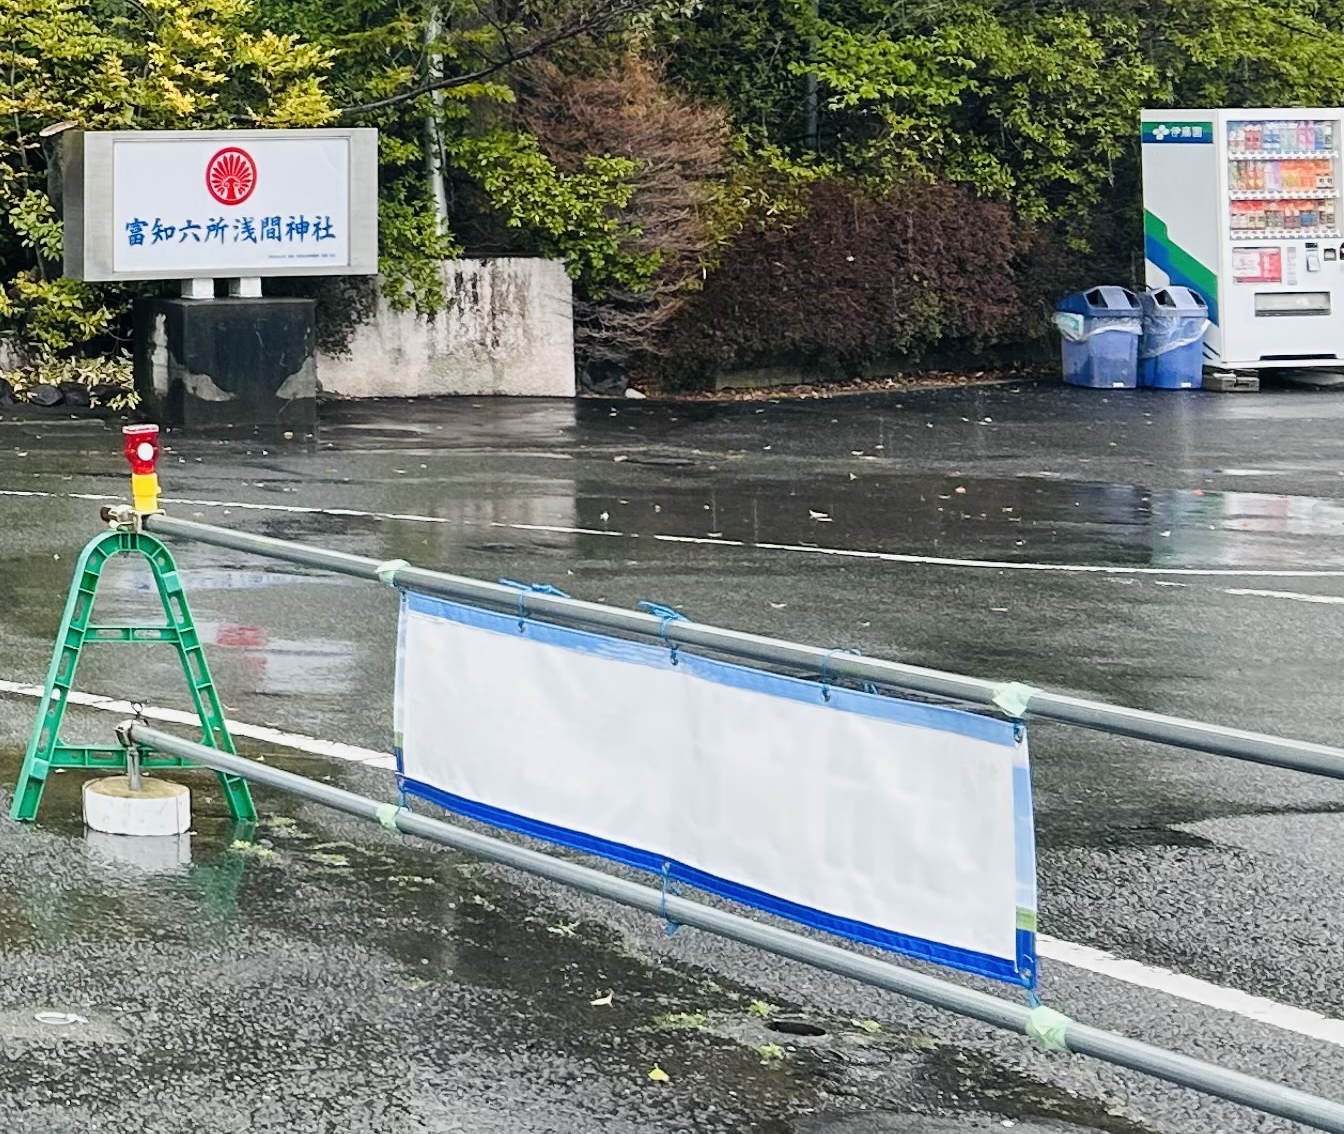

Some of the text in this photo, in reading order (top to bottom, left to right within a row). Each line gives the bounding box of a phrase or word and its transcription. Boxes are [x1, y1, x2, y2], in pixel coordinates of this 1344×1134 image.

[125, 215, 336, 246] 富知六所浅間神社
